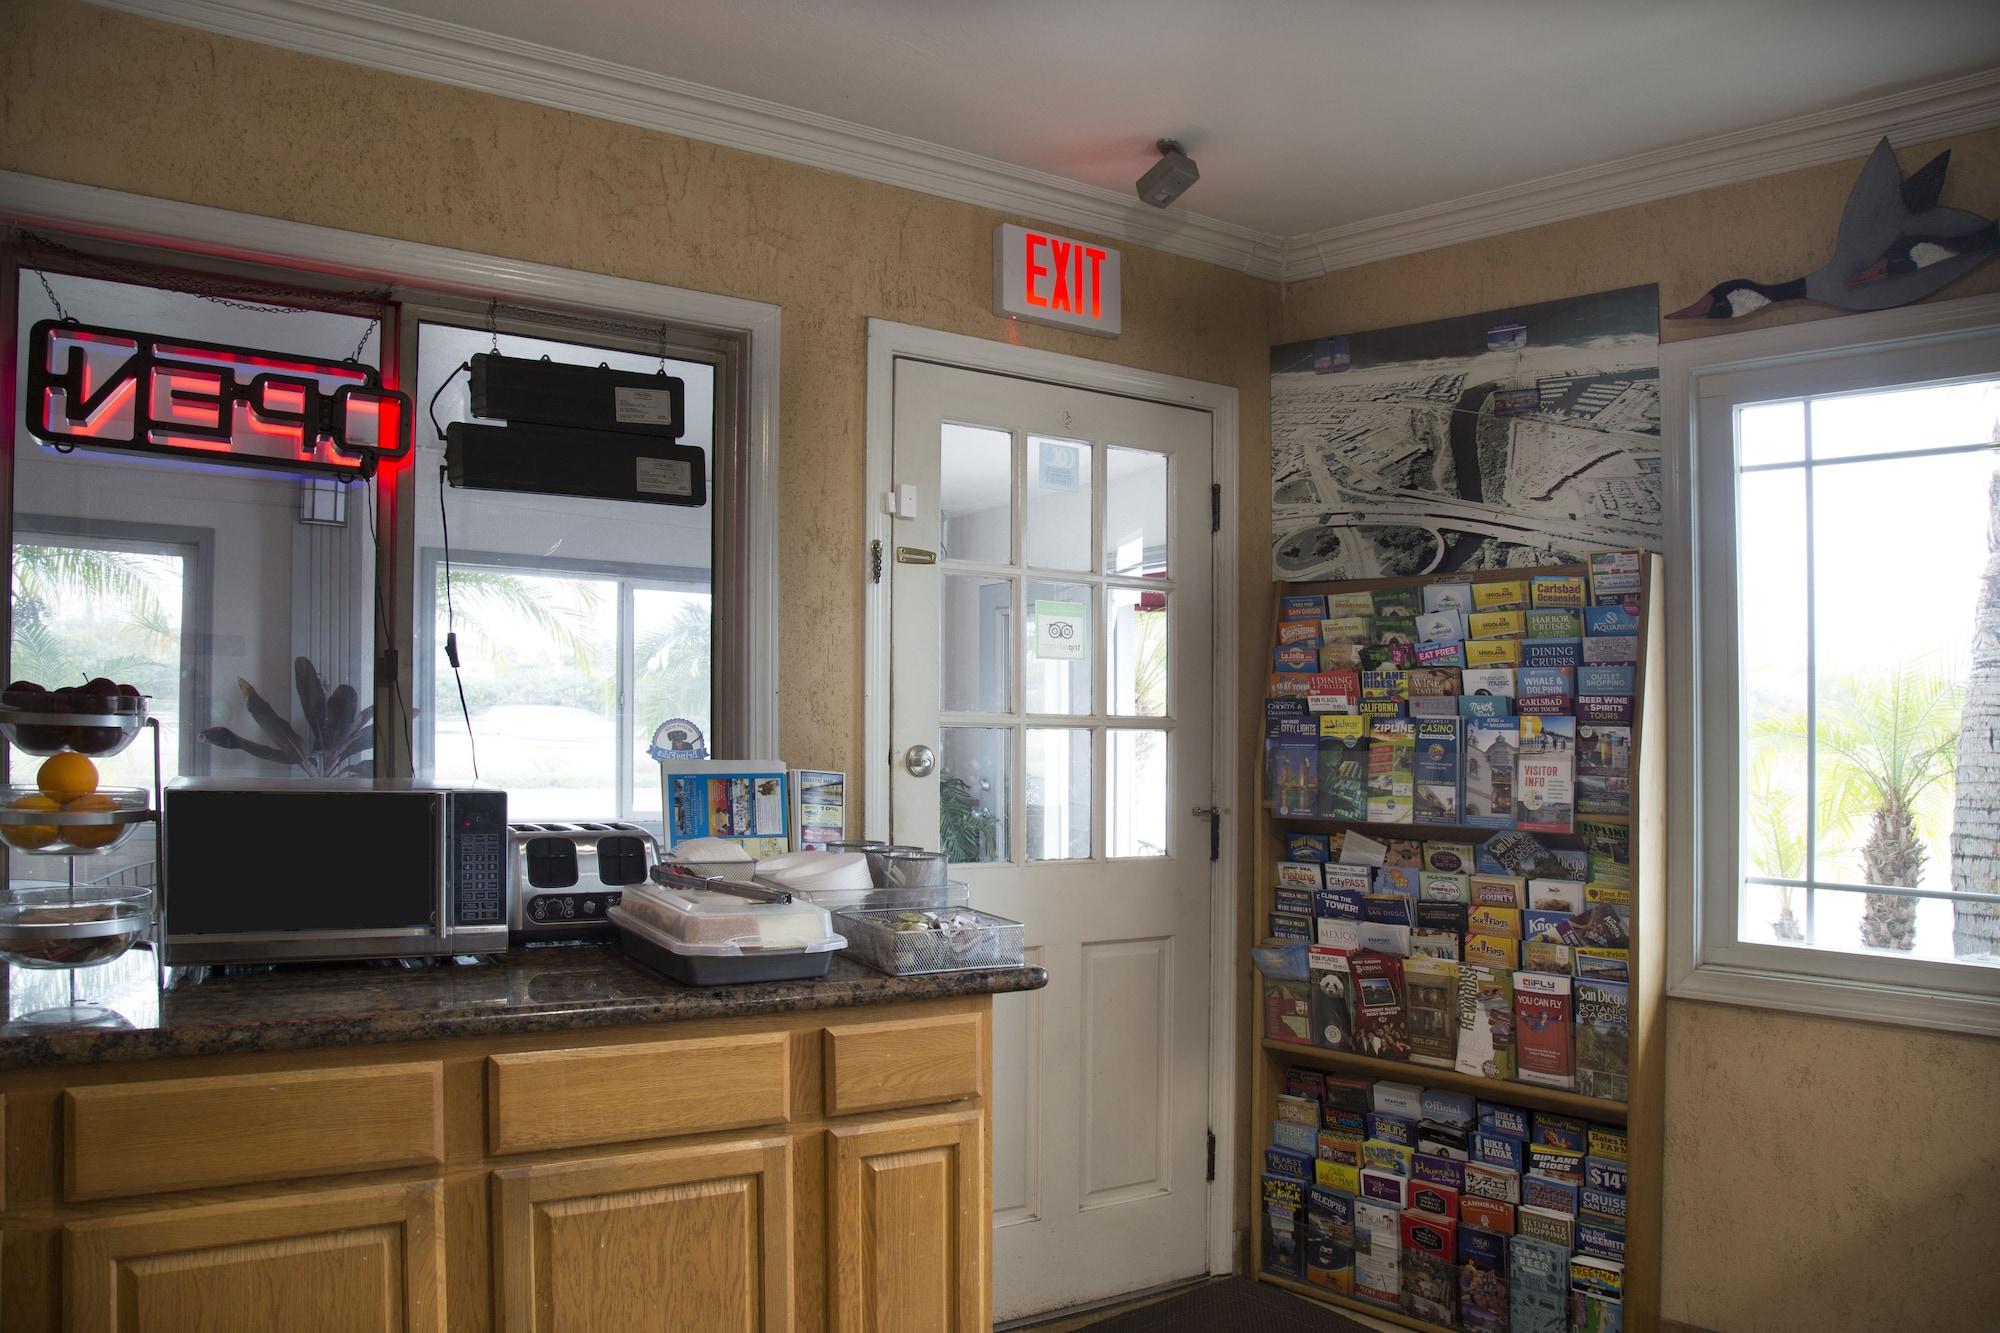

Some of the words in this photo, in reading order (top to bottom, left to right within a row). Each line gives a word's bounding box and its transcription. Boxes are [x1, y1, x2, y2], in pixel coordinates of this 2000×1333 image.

[1025, 232, 1107, 320] EXIT
[1537, 583, 1581, 594] Carlsbad
[1537, 594, 1582, 603] Oceanside
[1301, 608, 1321, 616] DIEGO
[1532, 615, 1570, 624] HARBOR
[1532, 623, 1571, 631] CRUISES
[1592, 622, 1638, 633] AQUARIUM
[1419, 650, 1435, 661] EAT
[1435, 646, 1457, 657] FREE
[1531, 646, 1574, 656] DINING
[1532, 657, 1575, 667] CRUISES
[1316, 676, 1352, 685] DINING
[1413, 678, 1441, 688] WINE
[1524, 676, 1555, 686] WHALE
[1555, 677, 1563, 685] &
[1586, 679, 1626, 687] SHOPPING
[1526, 685, 1563, 694] DOLPHIN
[1518, 697, 1563, 706] CARLSBAD
[1578, 696, 1603, 704] BEER
[1359, 702, 1399, 714] CALIFORNIA
[1589, 712, 1618, 720] TOURS
[1281, 724, 1293, 733] CITY
[1296, 724, 1316, 734] LIGHTS
[1331, 719, 1359, 730] Midway
[1374, 724, 1415, 733] ZIPLINE
[1419, 723, 1454, 733] CASINO
[1524, 765, 1558, 777] VISITOR
[1525, 776, 1545, 788] INFO
[1500, 836, 1533, 864] BOTANIC
[1505, 840, 1539, 870] GARDEN
[1282, 869, 1316, 885] Fishing
[1329, 877, 1366, 889] CityPASS
[1320, 892, 1339, 902] CLIMB
[1339, 895, 1352, 903] THE
[1479, 893, 1514, 903] COUNTY
[1325, 900, 1359, 914] TOWER!
[1472, 916, 1484, 924] Six
[1489, 917, 1509, 927] Flags
[1320, 929, 1357, 942] MEXICO
[1469, 944, 1481, 952] Six
[1486, 945, 1505, 956] Flags
[1606, 950, 1627, 958] Price
[1530, 978, 1556, 989] iFLY
[1517, 994, 1533, 1005] YOU
[1533, 997, 1549, 1007] CAN
[1549, 999, 1562, 1010] FLY
[1579, 986, 1596, 1002] San
[1597, 988, 1626, 1008] Diego
[1579, 1002, 1628, 1017] BOTANIC
[1579, 1011, 1628, 1024] GARDEN
[1426, 1038, 1440, 1046] OFF
[1424, 1100, 1461, 1113] Official
[1494, 1110, 1515, 1121] BIKE
[1495, 1119, 1524, 1132] KAYAK
[1483, 1138, 1504, 1148] BIKE
[1504, 1141, 1512, 1150] &
[1592, 1132, 1619, 1145] Bates
[1268, 1152, 1303, 1167] HEARST
[1484, 1146, 1513, 1161] KAYAK
[1532, 1152, 1580, 1166] BIPLANE
[1538, 1161, 1572, 1173] RIDES
[1310, 1189, 1347, 1213] HELICOPTER
[1420, 1198, 1441, 1208] PUBLIC
[1462, 1199, 1505, 1212] CANNIBALS
[1583, 1191, 1627, 1209] CRUISE
[1583, 1201, 1600, 1211] SAN
[1522, 1218, 1568, 1234] ULTIMATE
[1522, 1225, 1568, 1241] SHOPPING
[1579, 1231, 1625, 1251] YOSEMITE
[1515, 1246, 1552, 1261] CRAFT
[1519, 1256, 1550, 1272] BEER
[1571, 1265, 1596, 1278] FREE
[1599, 1270, 1619, 1284] MAP
